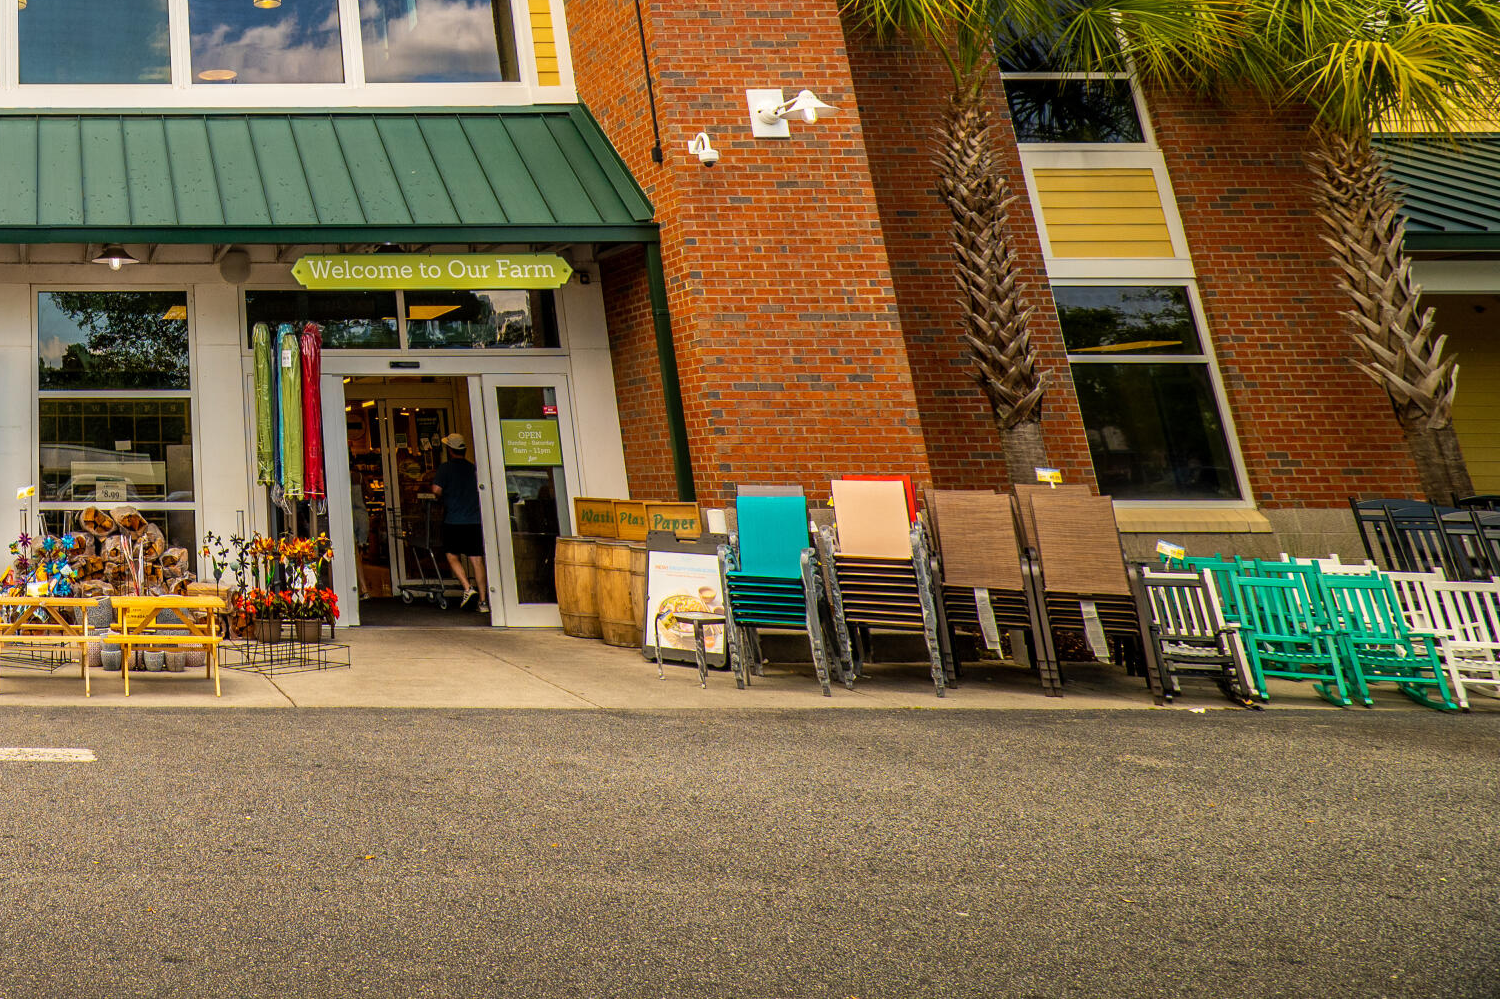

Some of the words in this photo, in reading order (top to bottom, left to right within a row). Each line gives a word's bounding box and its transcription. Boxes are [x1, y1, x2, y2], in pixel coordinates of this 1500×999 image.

[307, 259, 413, 280] Welcome
[419, 262, 441, 280] to
[447, 259, 491, 279] Our
[496, 259, 556, 279] Farm
[518, 431, 542, 439] OPEN
[653, 514, 695, 531] Paper
